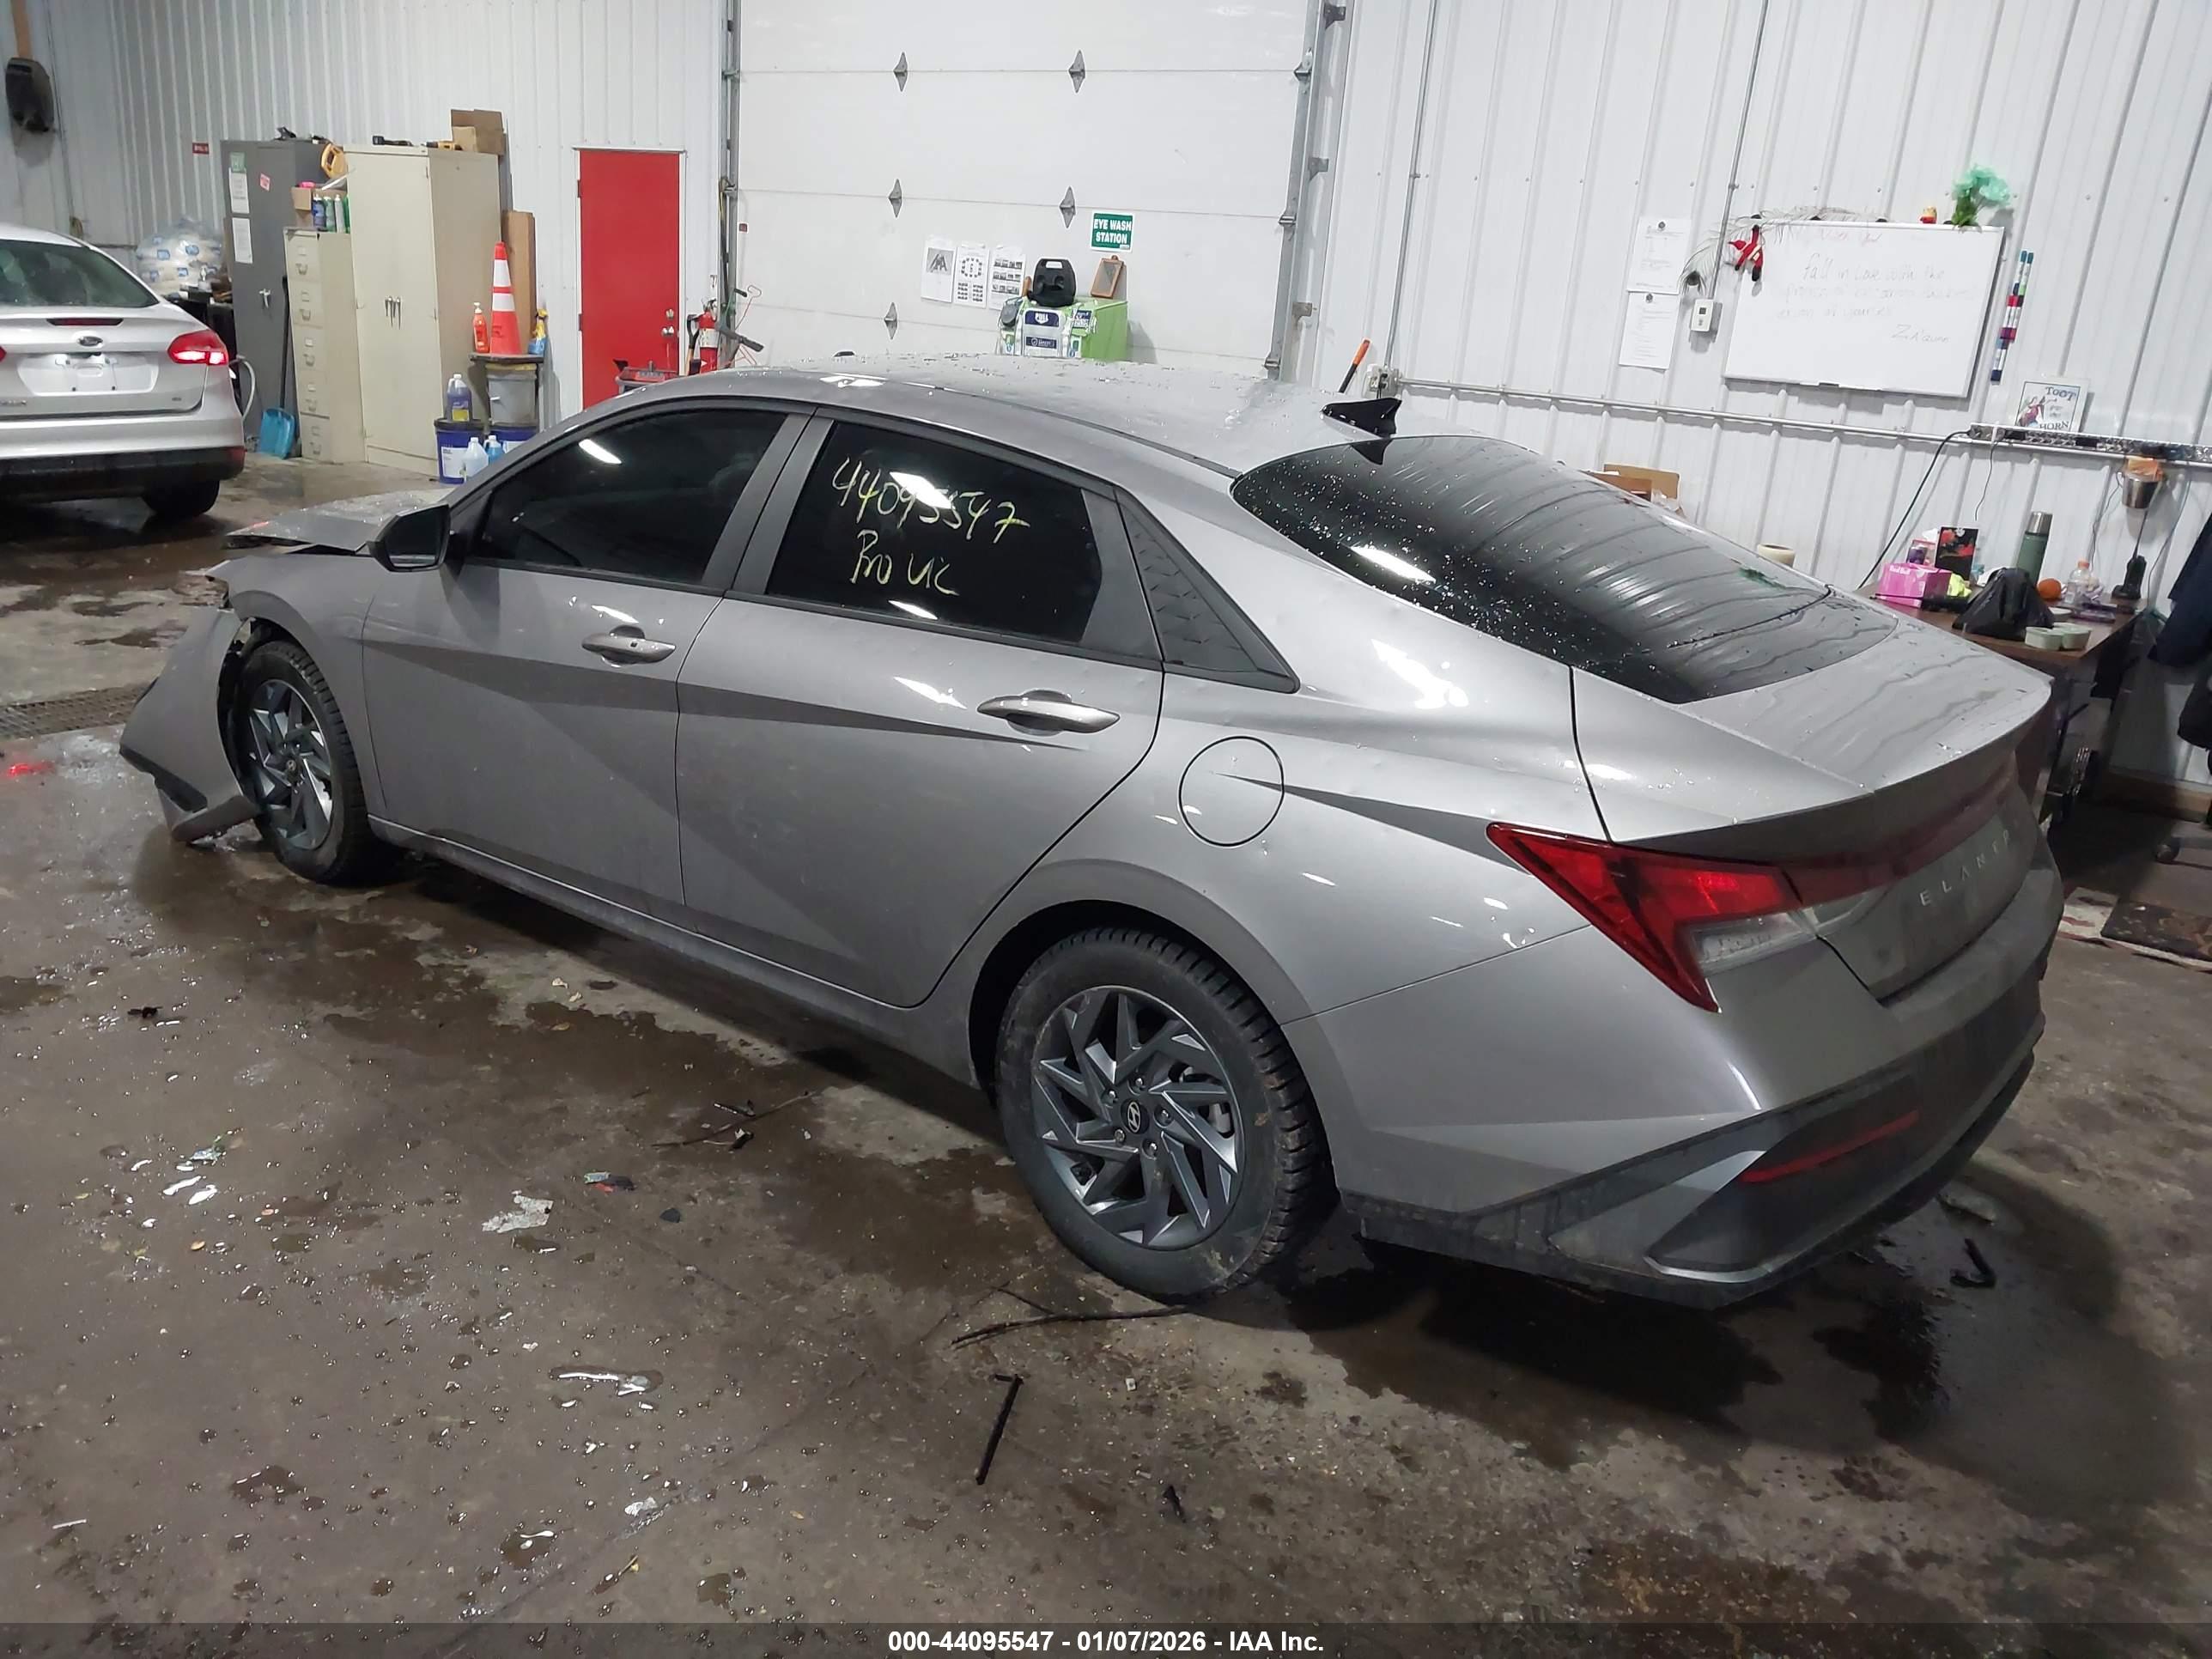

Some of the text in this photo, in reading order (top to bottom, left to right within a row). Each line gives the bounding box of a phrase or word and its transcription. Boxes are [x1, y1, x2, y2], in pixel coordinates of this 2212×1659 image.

[1093, 218, 1132, 232] EYE WASH
[1096, 231, 1127, 244] STATION
[2039, 421, 2069, 430] HORN
[831, 456, 1030, 544] 44095547
[1919, 817, 2019, 907] ELANTR
